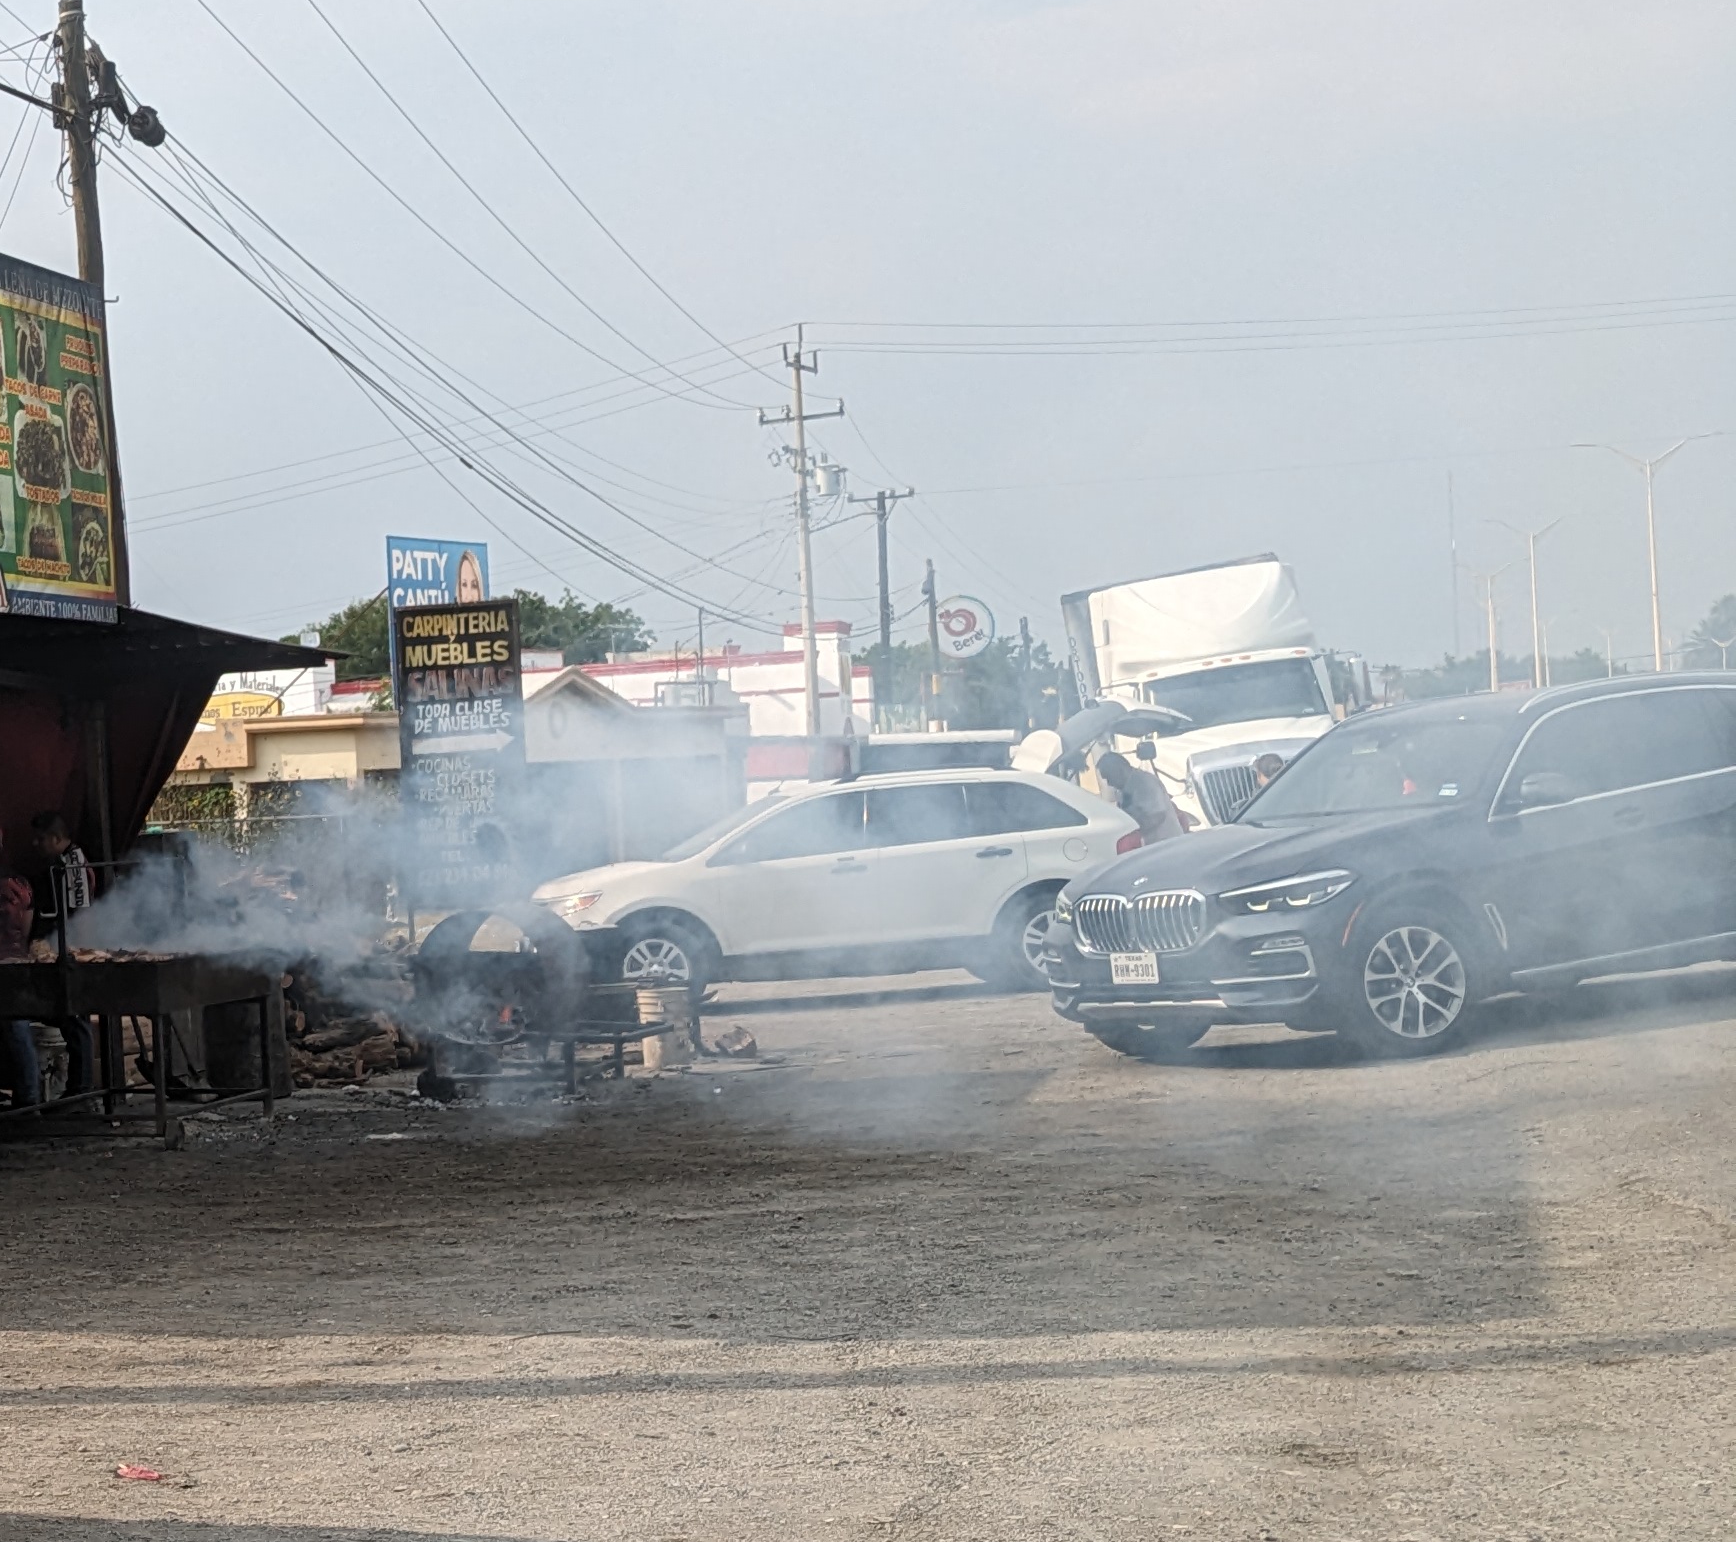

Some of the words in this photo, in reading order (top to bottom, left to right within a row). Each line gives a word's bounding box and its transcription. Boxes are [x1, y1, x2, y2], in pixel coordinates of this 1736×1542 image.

[392, 549, 449, 581] PATTY
[58, 602, 80, 620] 100%
[402, 610, 509, 638] CARPINTERIA
[405, 639, 510, 667] MUEBLES
[407, 666, 515, 702] SALINAS
[416, 703, 450, 719] TODA
[456, 698, 503, 716] CLASE
[414, 718, 433, 735] DE
[437, 711, 512, 733] MUEBLES
